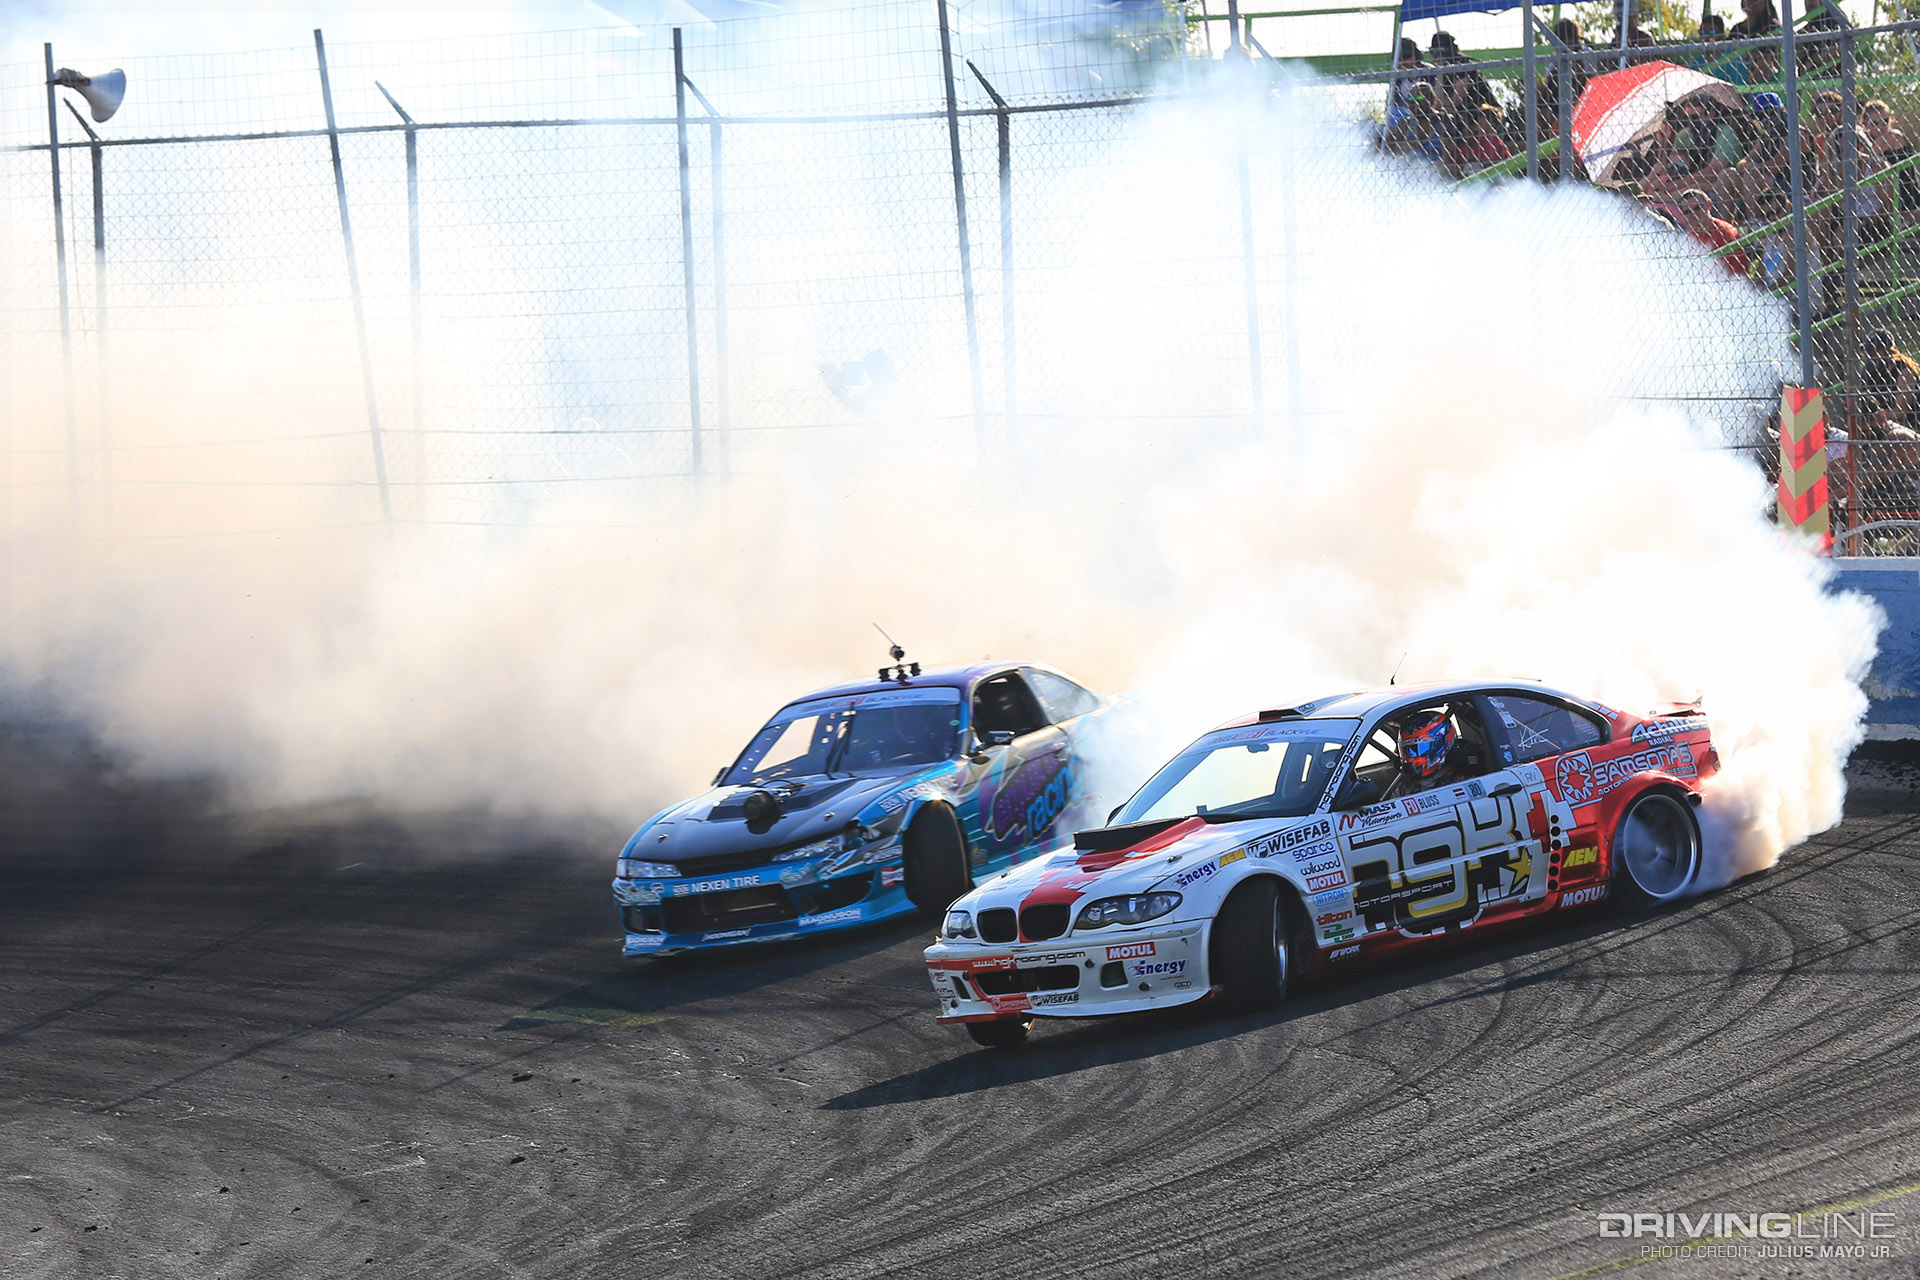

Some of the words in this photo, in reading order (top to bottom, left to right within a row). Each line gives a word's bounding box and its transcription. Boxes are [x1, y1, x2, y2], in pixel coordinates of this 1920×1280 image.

[1648, 735, 1674, 746] RADIAL
[1468, 783, 1482, 797] 80
[1358, 801, 1397, 817] MAST
[1419, 795, 1441, 809] BLUSS
[1361, 812, 1403, 828] Motorsports
[1267, 820, 1331, 853] WISEFAB
[1219, 848, 1247, 869] AEM
[1292, 841, 1335, 862] sparco
[1562, 846, 1598, 868] AEM
[1300, 854, 1341, 876] wilwood
[1177, 861, 1217, 890] Energy
[1309, 872, 1345, 891] MOTUL
[691, 879, 731, 894] NEXEN
[731, 875, 761, 889] TIRE
[1314, 888, 1347, 905] NITRON
[1316, 910, 1353, 926] tilton
[1108, 943, 1154, 960] MOTUL
[1138, 959, 1187, 977] Energy
[1041, 993, 1080, 1005] WISEFAB
